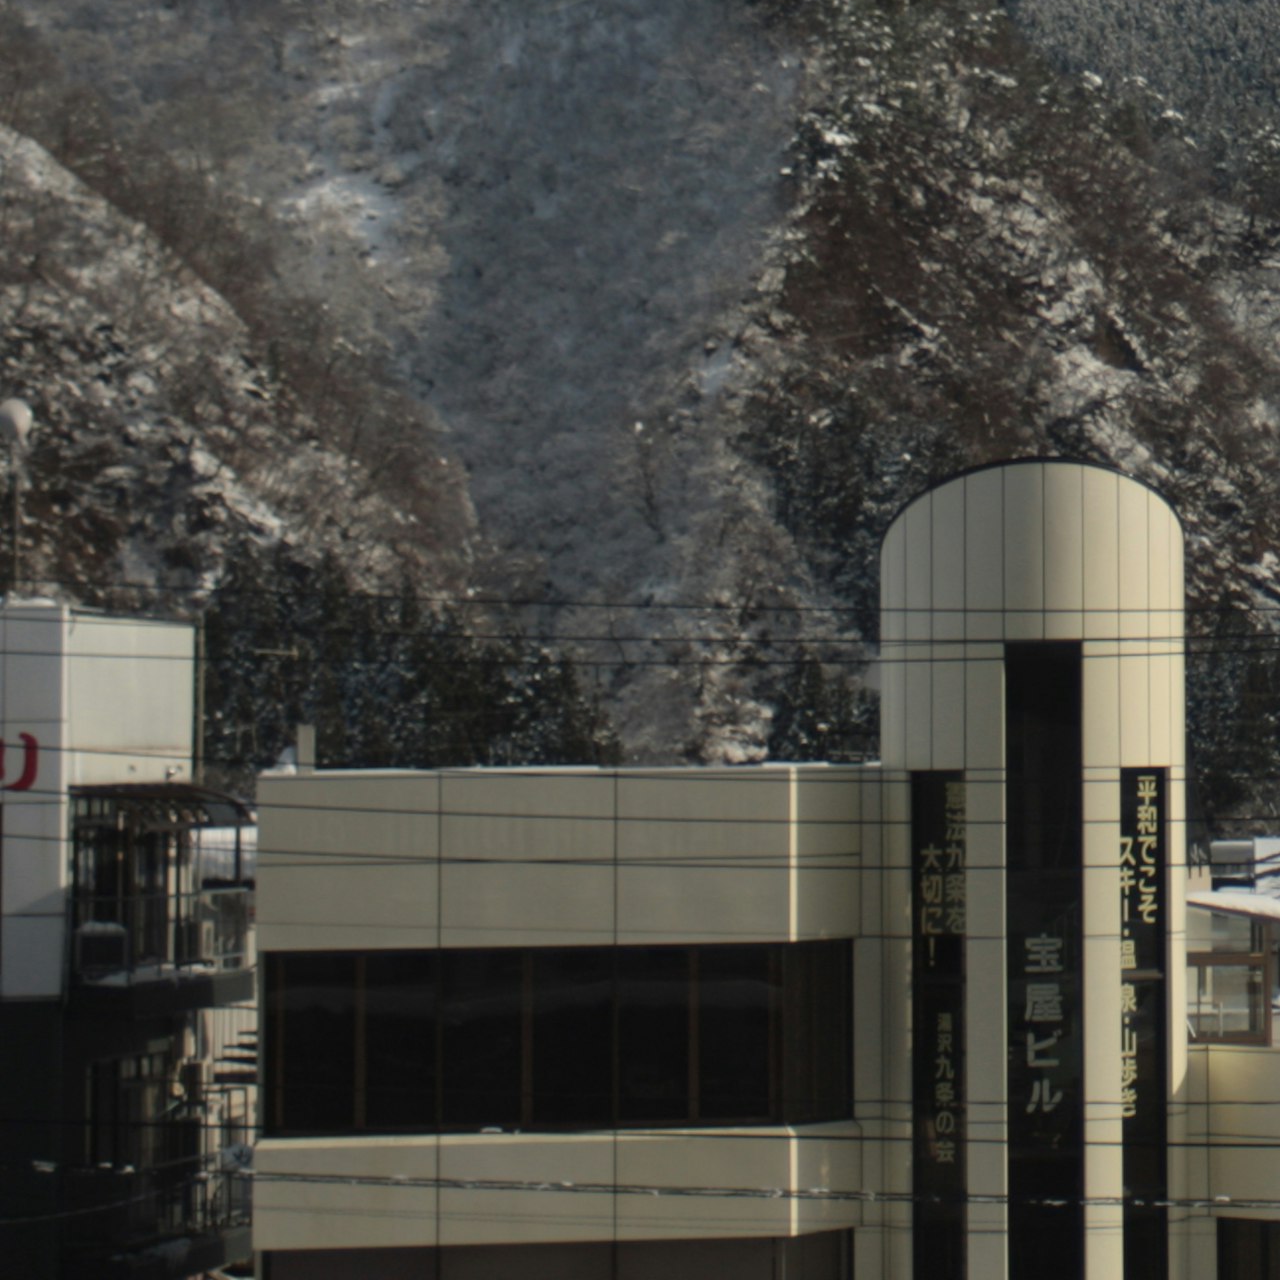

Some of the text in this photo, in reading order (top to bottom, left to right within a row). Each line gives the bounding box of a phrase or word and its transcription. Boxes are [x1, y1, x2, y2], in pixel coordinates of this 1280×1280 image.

[1137, 775, 1158, 924] 平和でこそ
[1024, 933, 1064, 1114] 宝屋ビル
